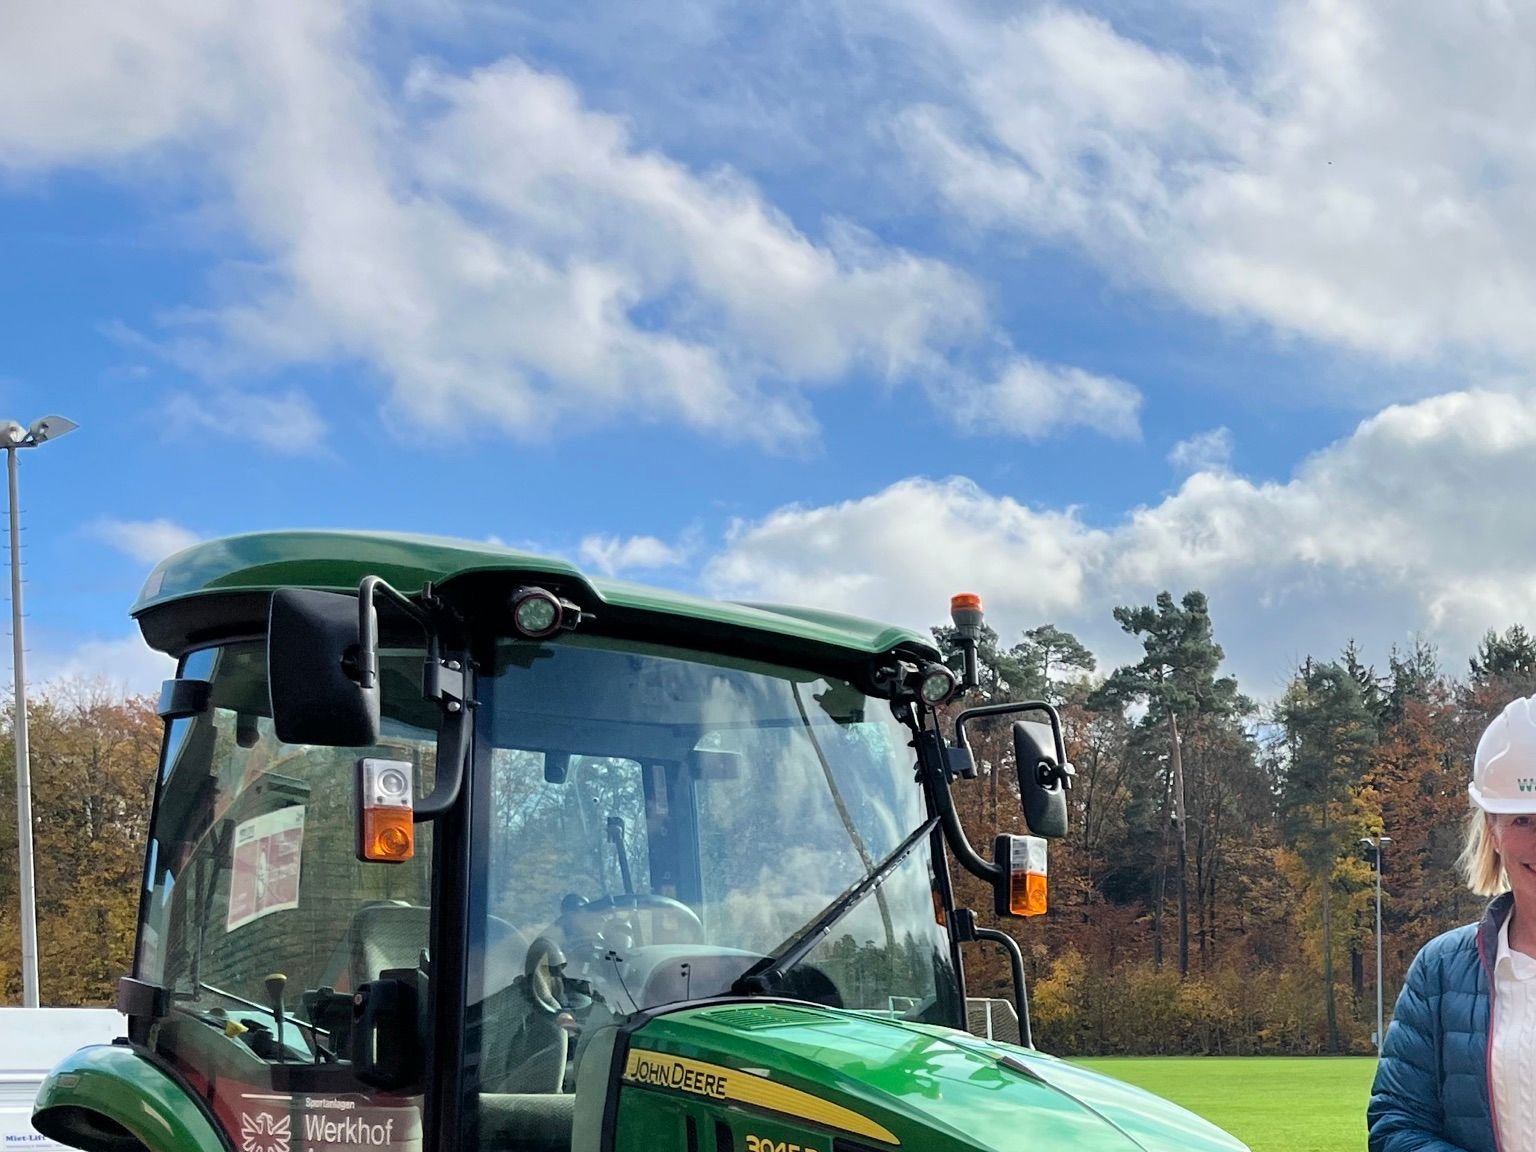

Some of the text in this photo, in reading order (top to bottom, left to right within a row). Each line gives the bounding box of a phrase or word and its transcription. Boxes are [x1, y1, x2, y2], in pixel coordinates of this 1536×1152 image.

[630, 1056, 728, 1096] JOHN DEERE
[305, 1114, 394, 1146] Werkhof
